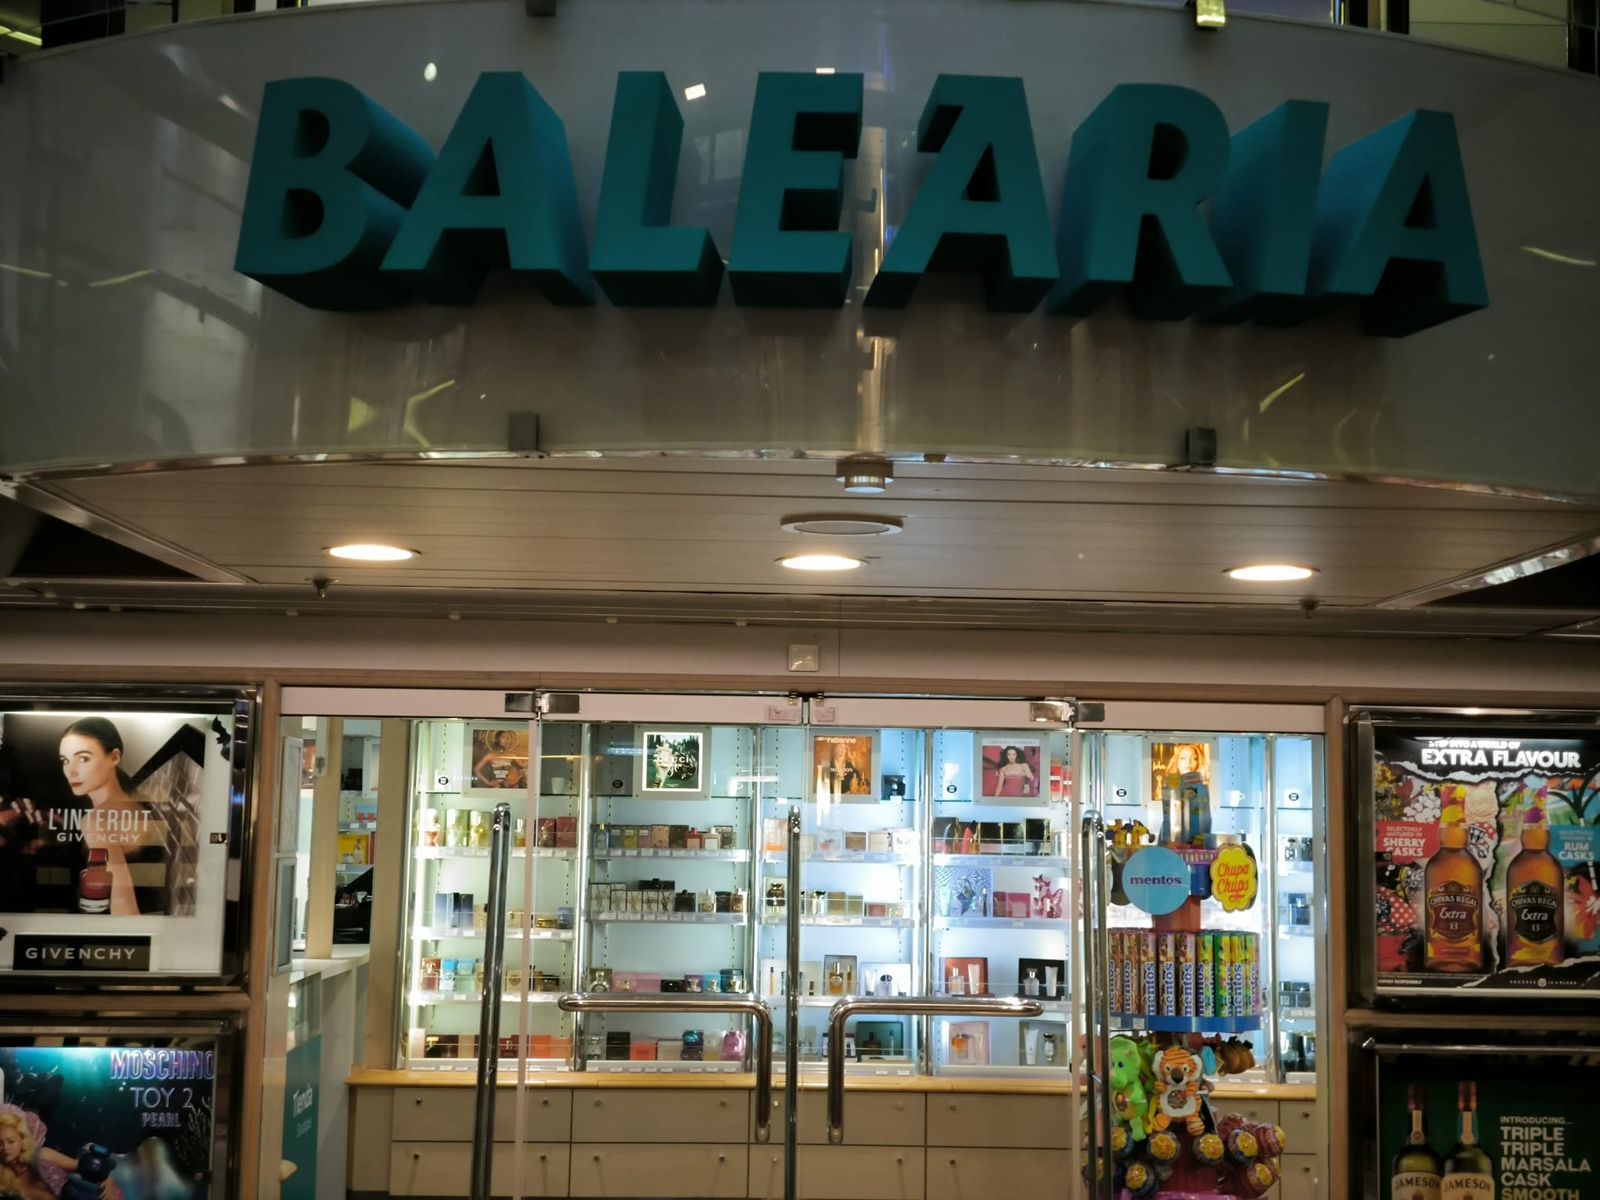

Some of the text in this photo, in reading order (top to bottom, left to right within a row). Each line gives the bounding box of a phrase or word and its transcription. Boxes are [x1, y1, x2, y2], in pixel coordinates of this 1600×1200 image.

[1421, 749, 1582, 768] EXTRA FLAVOUR
[48, 808, 152, 832] L'INTERDIT
[57, 832, 141, 843] GIVENCHY
[1383, 837, 1426, 847] SHERRY
[1563, 841, 1590, 851] RUM
[1558, 850, 1595, 861] CASKS
[1217, 863, 1249, 878] Chupa
[1130, 875, 1182, 885] mentos
[1217, 878, 1249, 894] Chups
[1439, 907, 1467, 919] Extra
[1521, 908, 1548, 920] Extra
[25, 947, 136, 960] GIVENCHY
[1144, 962, 1156, 1016] mentos
[1164, 962, 1175, 1016] mentos
[1183, 963, 1194, 1017] mentos
[110, 1049, 215, 1080] MOSCHINO
[130, 1087, 194, 1108] TOY 2
[142, 1112, 181, 1127] PEARL
[1500, 1126, 1565, 1141] TRIPLE
[1500, 1142, 1565, 1156] TRIPLE
[1501, 1157, 1592, 1172] MARSALA
[1444, 1177, 1491, 1192] JAMESON
[1501, 1172, 1551, 1187] CASK
[1502, 1188, 1580, 1200] SMOOTH
